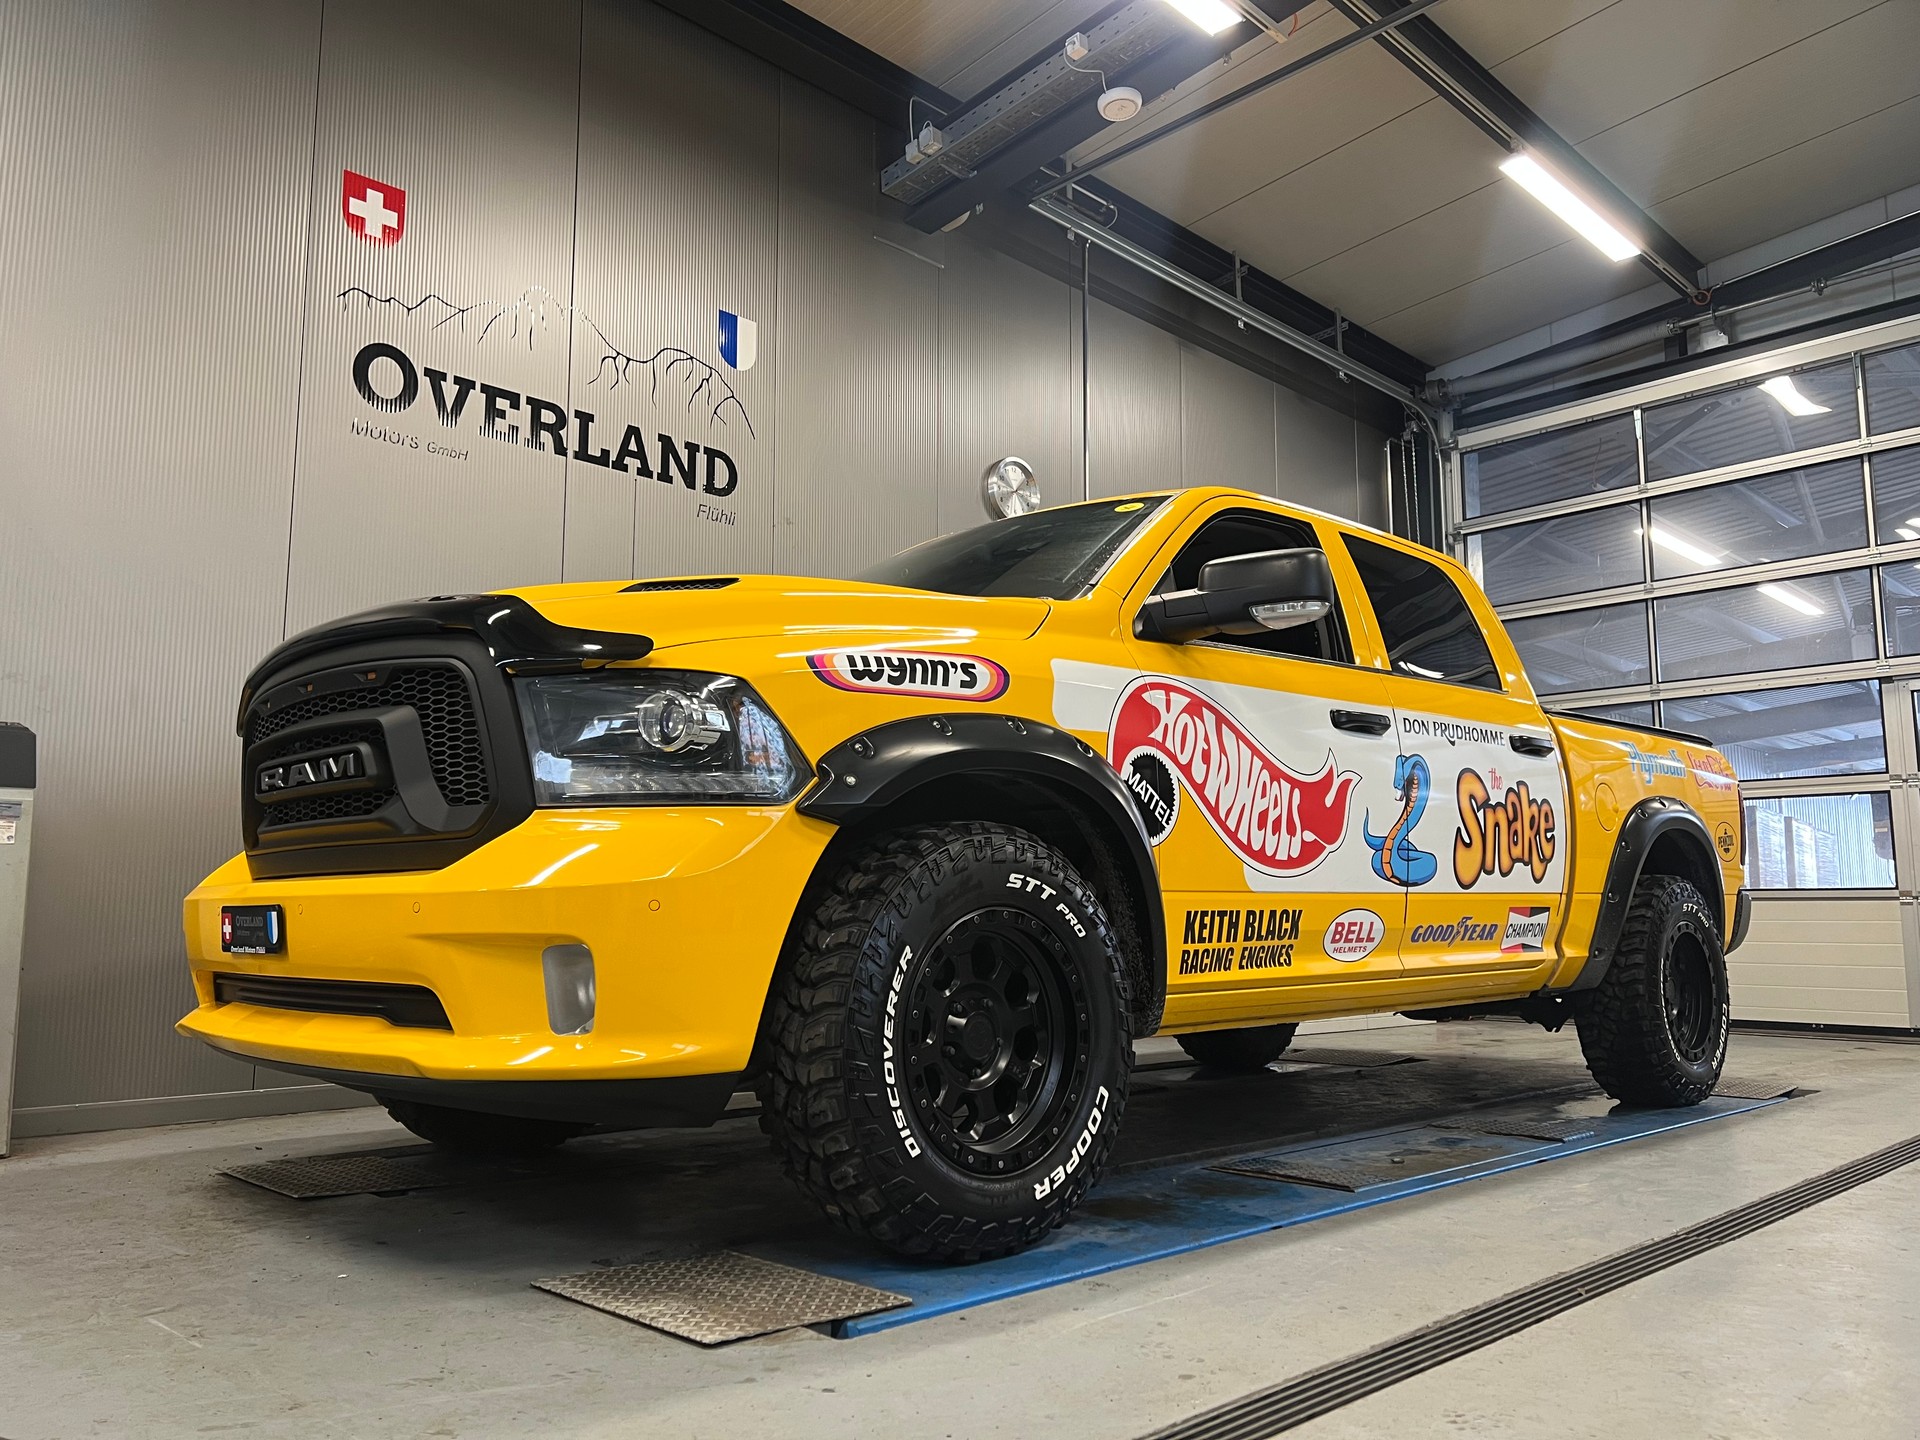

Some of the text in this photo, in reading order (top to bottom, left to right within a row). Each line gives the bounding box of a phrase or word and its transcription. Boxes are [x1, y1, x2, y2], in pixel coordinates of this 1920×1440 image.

[351, 417, 469, 461] Motors GmbH
[352, 342, 738, 498] OVERLAND
[696, 503, 737, 526] Flühli
[1141, 689, 1210, 784] Hot
[1402, 717, 1506, 746] DON PRUDHOMME
[260, 752, 355, 792] RAM
[1488, 767, 1503, 790] the
[1619, 741, 1687, 785] Plymouth
[1124, 766, 1173, 828] MATTEL
[1453, 767, 1555, 890] Snake
[1006, 872, 1087, 938] STT PRO
[1682, 902, 1710, 928] STT PRO
[1183, 908, 1303, 945] KEITH BLACK
[1330, 921, 1376, 945] BELL
[1505, 921, 1546, 939] CHAMPION
[1179, 943, 1294, 975] RACING ENGINES
[1332, 945, 1368, 954] HELMETS
[883, 944, 922, 1158] DISCOVERER
[1712, 1002, 1727, 1071] COOPER
[1032, 1085, 1110, 1201] COOPER
